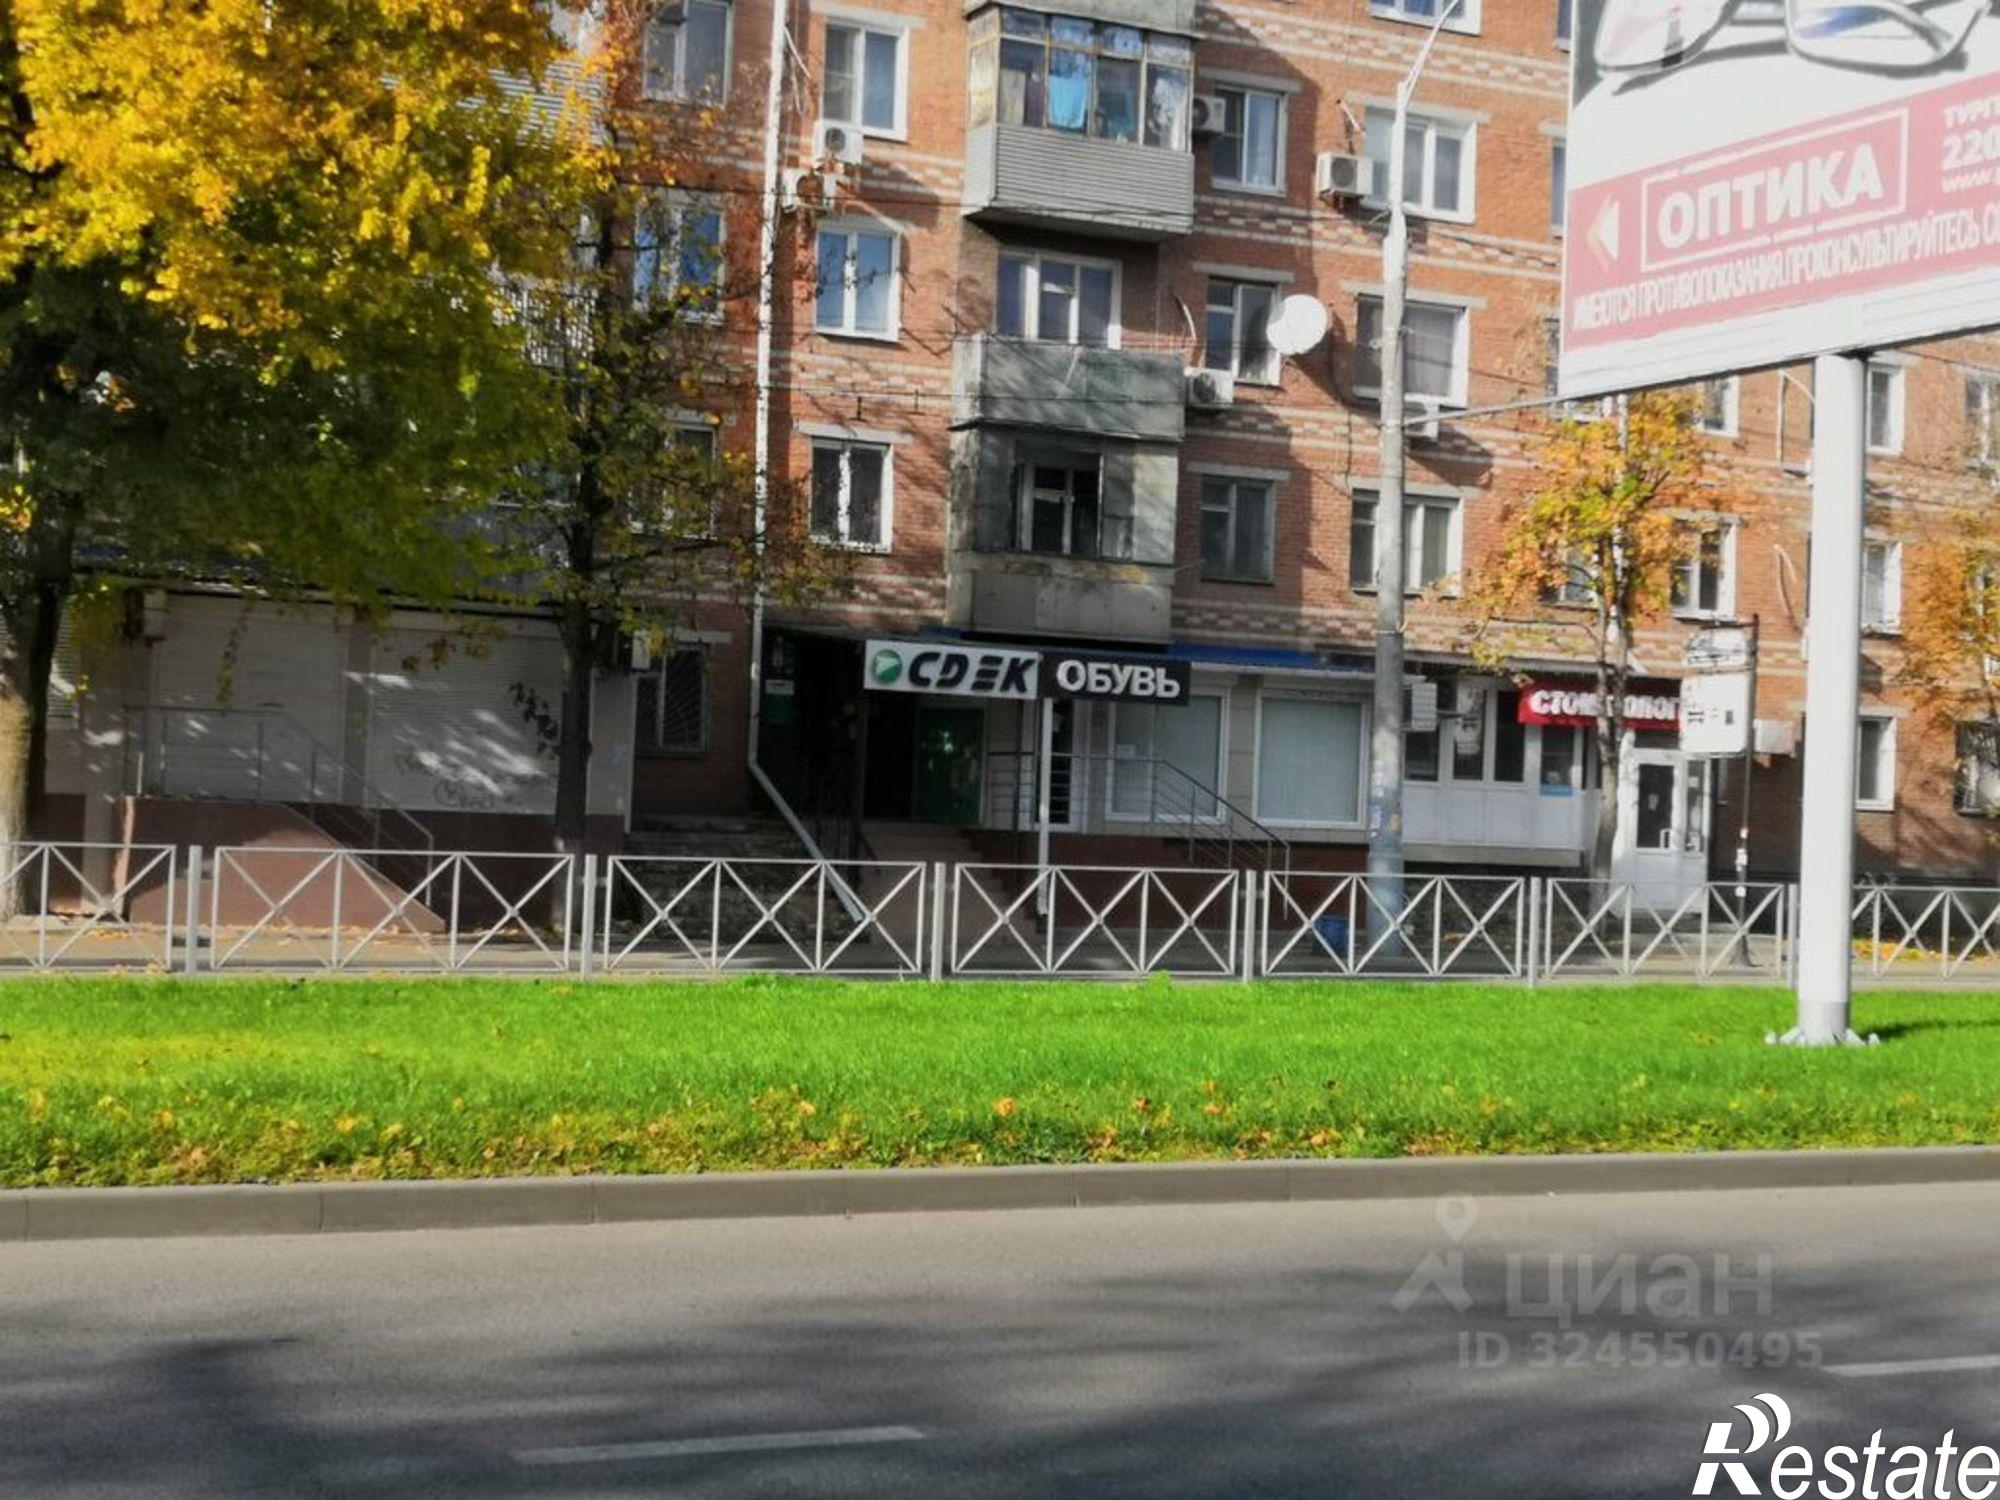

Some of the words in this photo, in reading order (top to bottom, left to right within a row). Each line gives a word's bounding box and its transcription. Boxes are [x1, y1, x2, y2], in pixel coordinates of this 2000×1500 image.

[1659, 143, 1883, 249] ОПТИКА
[908, 651, 1035, 693] CDEK
[1056, 660, 1180, 698] ОБУВЬ
